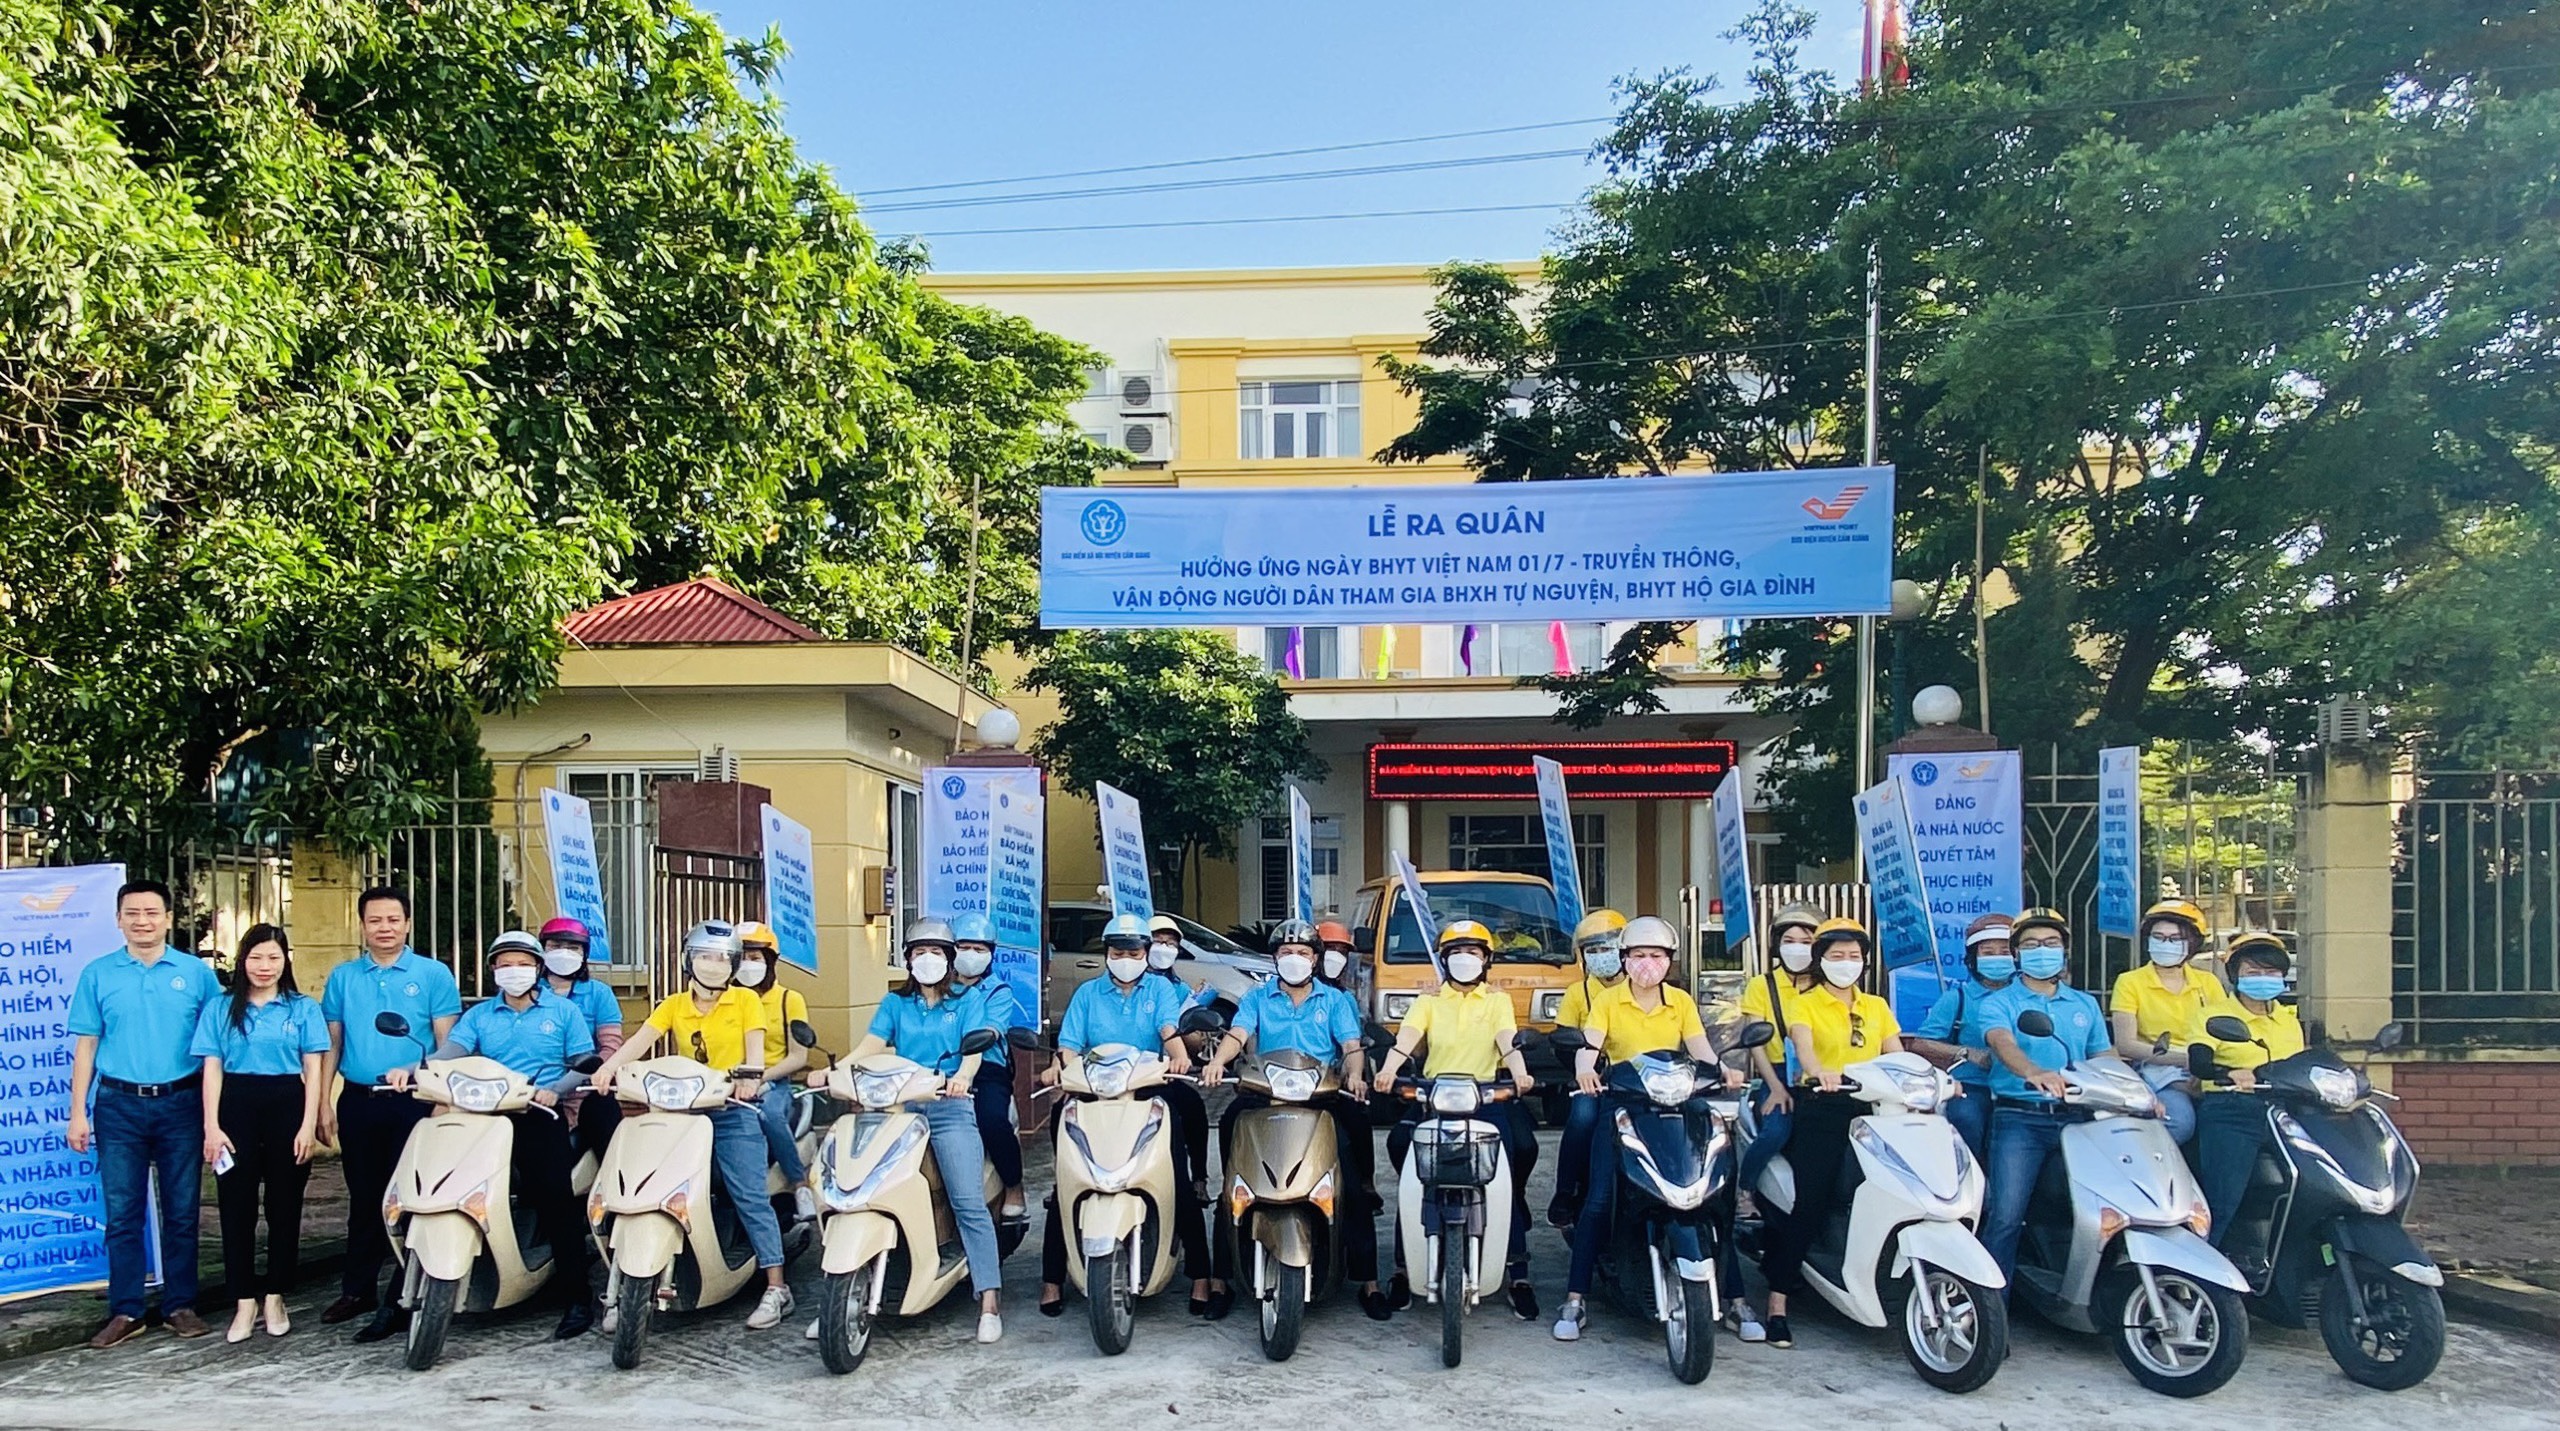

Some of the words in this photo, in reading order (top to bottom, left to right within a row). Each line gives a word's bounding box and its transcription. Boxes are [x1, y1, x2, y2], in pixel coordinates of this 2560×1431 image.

[1368, 503, 1396, 537] LỄ
[1406, 513, 1443, 536] RA
[1456, 505, 1546, 536] QUÂN
[1181, 555, 1252, 578] HƯỞNG
[1259, 554, 1300, 577] ỨNG
[1307, 553, 1362, 576] NGÀY
[1369, 556, 1416, 575] BHYT
[1421, 551, 1461, 579] VIỆT
[1467, 554, 1511, 573] NAM
[1518, 553, 1564, 572] 01/7
[1582, 544, 1656, 571] TRUYỀN
[1661, 545, 1741, 571] THÔNG,
[1113, 586, 1152, 611] VẬN
[1158, 585, 1217, 612] ĐỘNG
[1224, 582, 1286, 606] NGƯỜI
[1294, 582, 1335, 605] DÂN
[1341, 586, 1394, 605] THAM
[1401, 585, 1437, 603] GIA
[1443, 583, 1496, 602] BHXH
[1503, 582, 1526, 606] TỰ
[1533, 577, 1619, 606] NGUYỆN,
[1626, 580, 1676, 599] BHYT
[1682, 576, 1712, 604] HỘ
[1719, 580, 1757, 597] GIA
[1764, 572, 1815, 596] ĐÌNH
[1935, 793, 1977, 810] ĐẢNG
[955, 807, 979, 820] BẢO
[961, 825, 976, 838] XÃ
[1930, 820, 1958, 836] NHÀ
[1963, 818, 2004, 835] NƯỚC
[943, 842, 966, 857] BẢO
[969, 841, 989, 857] HIỂ
[1918, 844, 1962, 862] QUYẾT
[1966, 845, 1995, 861] TÂM
[940, 861, 953, 875] LÀ
[955, 879, 979, 892] BẢO
[1962, 872, 1993, 891] HIỆN
[952, 897, 976, 910] CỦA
[1957, 895, 1991, 914] HIỂM
[22, 933, 72, 956] HIỂM
[1002, 951, 1026, 964] DÂN
[19, 965, 63, 988] HỘI,
[2, 990, 53, 1014] HIỂM
[59, 994, 72, 1010] Y
[29, 1075, 74, 1097] ĐẢN
[13, 1160, 72, 1184] NHÂN
[77, 1184, 97, 1204] VÌ
[53, 1213, 96, 1235] TIÊU
